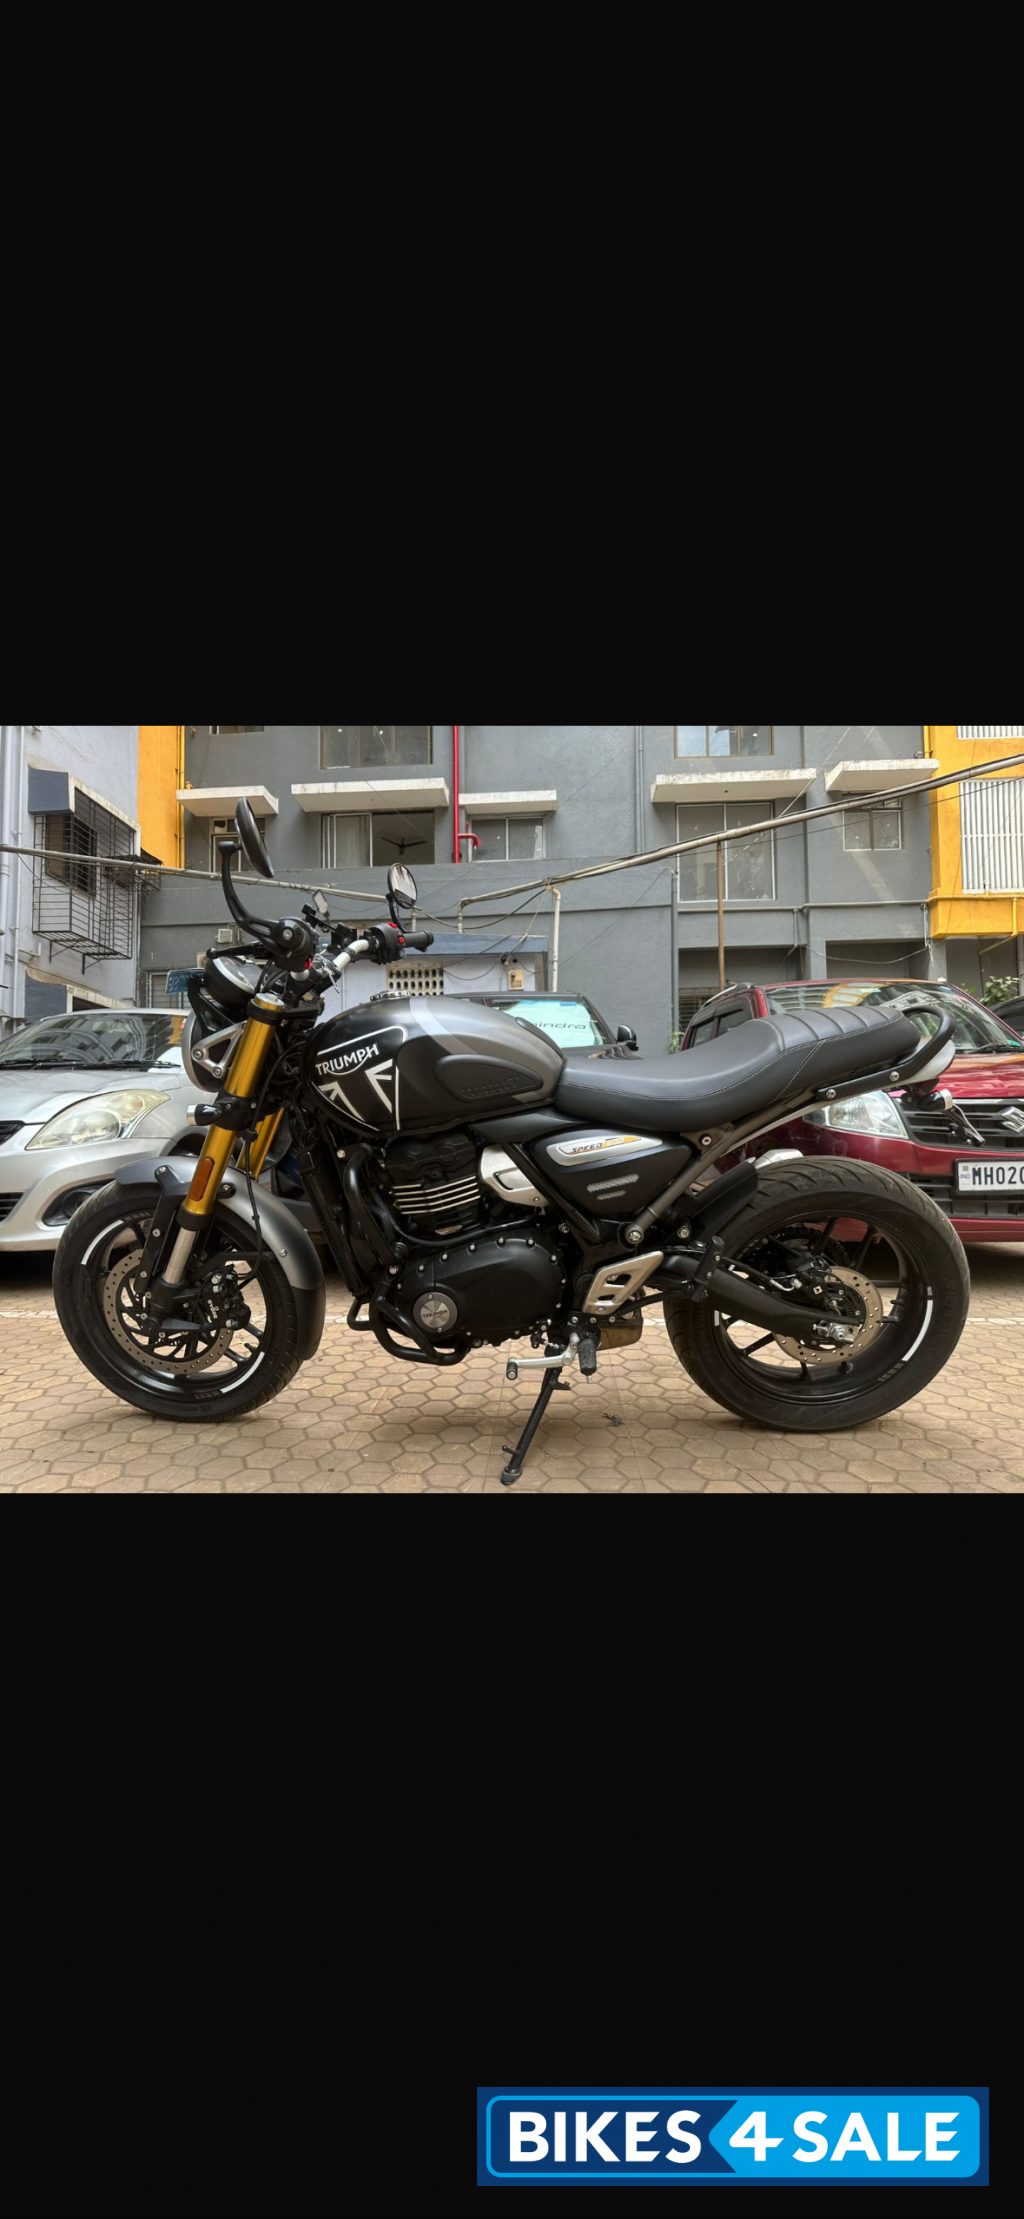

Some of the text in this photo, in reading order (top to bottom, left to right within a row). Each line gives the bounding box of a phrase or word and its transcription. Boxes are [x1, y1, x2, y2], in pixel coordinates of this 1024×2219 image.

[315, 1043, 379, 1075] TRIUMPH
[572, 1142, 602, 1153] SPEED
[422, 1309, 449, 1319] TRIUMPH
